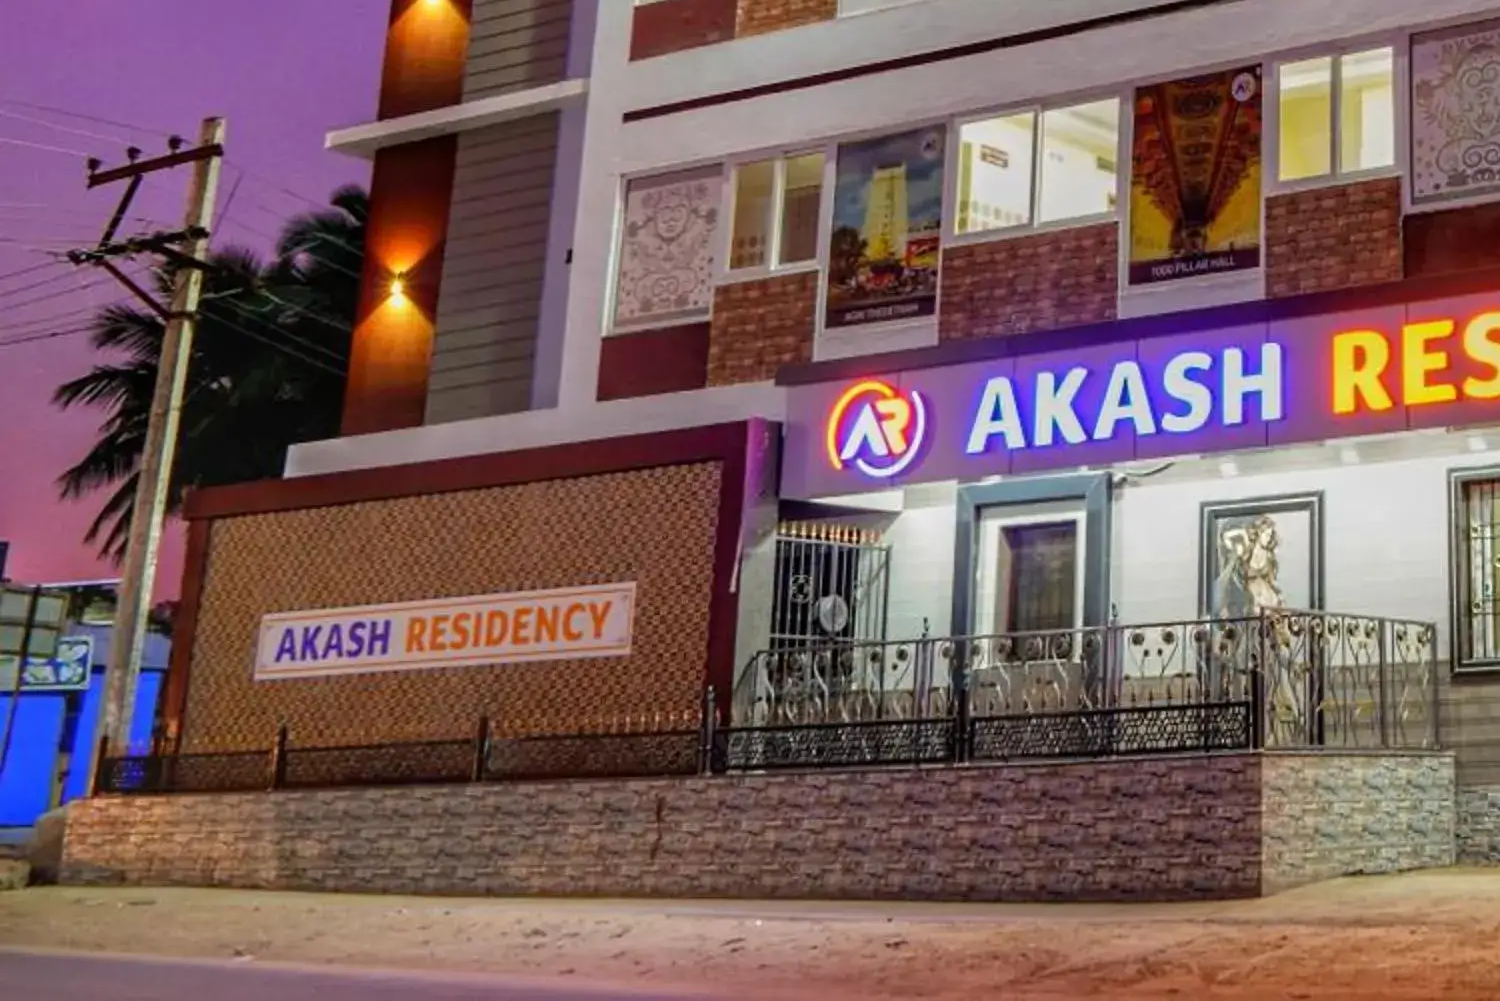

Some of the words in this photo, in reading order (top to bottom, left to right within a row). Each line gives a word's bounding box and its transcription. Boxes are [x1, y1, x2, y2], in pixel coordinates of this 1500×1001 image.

[966, 342, 1283, 454] AKASH
[274, 619, 392, 663] AKASH
[404, 601, 613, 653] RESIDENCY
